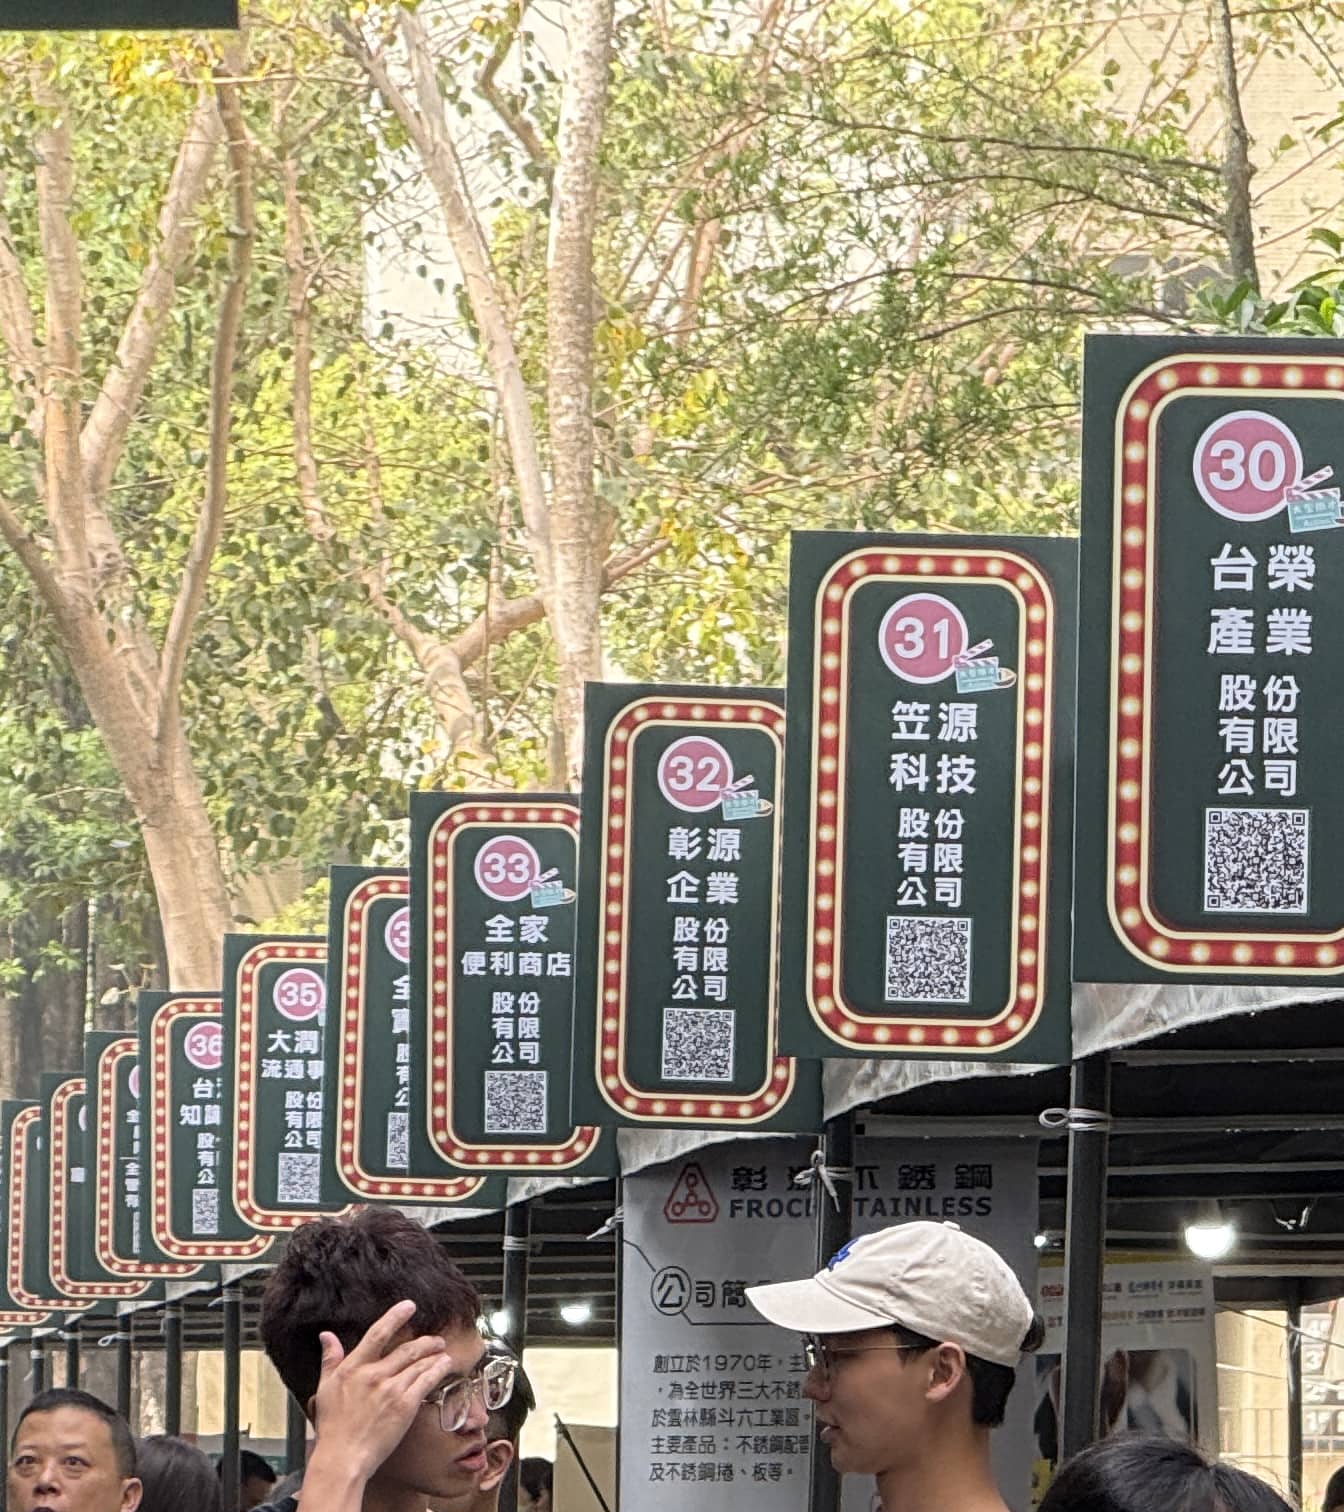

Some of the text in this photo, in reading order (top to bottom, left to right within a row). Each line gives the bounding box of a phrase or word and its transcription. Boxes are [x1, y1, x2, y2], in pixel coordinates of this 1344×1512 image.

[1209, 440, 1286, 492] 30
[1210, 543, 1316, 593] 台榮
[894, 618, 950, 660] 31
[1207, 607, 1313, 656] 產業
[1219, 674, 1300, 713] 股份
[890, 700, 979, 744] 笠源
[1218, 717, 1299, 756] 有限
[668, 757, 720, 791] 32
[889, 753, 977, 795] 科技
[1218, 759, 1298, 797] 公司
[898, 808, 965, 840] 股份
[668, 828, 741, 861] 彰源
[897, 842, 963, 874] 有限
[483, 853, 530, 884] 33
[666, 871, 739, 905] 企業
[896, 877, 963, 908] 公司
[484, 914, 549, 944] 全家
[673, 918, 730, 943] 股份
[461, 951, 571, 978] 便利商店
[673, 946, 729, 972] 有限
[281, 983, 318, 1007] 35
[492, 991, 540, 1015] 股份
[672, 975, 728, 1001] 公司
[267, 1030, 322, 1054] 大潤
[492, 1017, 540, 1039] 有限
[191, 1036, 223, 1057] 36
[492, 1042, 540, 1065] 公司
[192, 1078, 222, 1099] 台
[853, 1196, 992, 1217] TAINLESS
[656, 1271, 760, 1309] 公司簡
